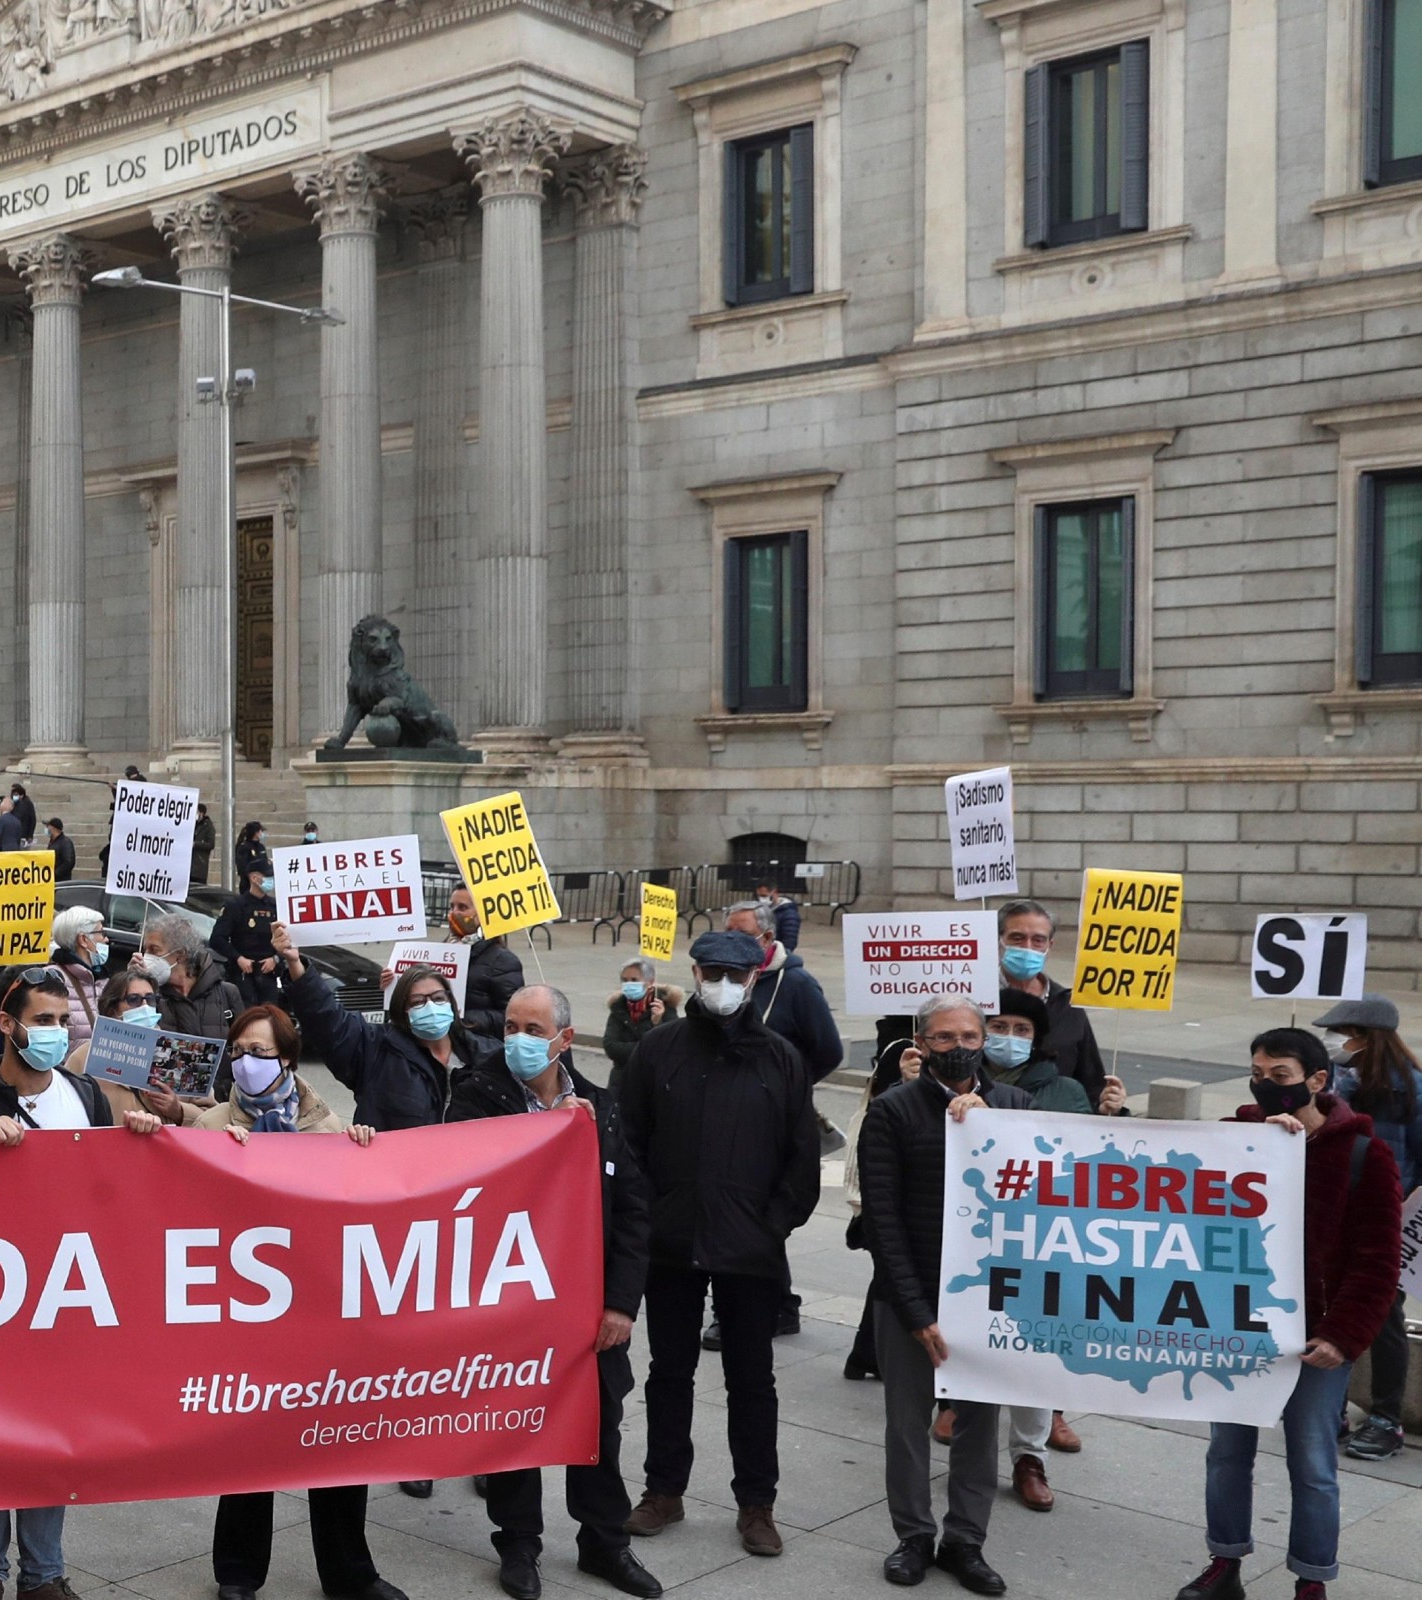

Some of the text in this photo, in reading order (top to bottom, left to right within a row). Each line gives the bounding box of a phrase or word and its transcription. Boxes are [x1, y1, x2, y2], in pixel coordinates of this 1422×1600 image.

[65, 171, 90, 200] DE
[106, 156, 146, 187] LOS
[164, 110, 297, 171] DIPUTADOS
[118, 786, 193, 826] Poder elegir
[955, 781, 1004, 816] ¡Sadismo
[126, 827, 174, 857] el morir
[458, 803, 525, 852] ¡NADIE
[960, 817, 1006, 847] sanitario,
[288, 848, 403, 874] #LIBRES
[467, 843, 541, 885] DECIDA
[957, 854, 1014, 886] nunca más!
[116, 864, 173, 895] sin sufrir.
[289, 871, 405, 892] HASTA EL
[1, 896, 46, 921] morir
[292, 888, 408, 922] FINAL
[482, 876, 551, 925] POR TÍ!
[643, 889, 674, 910] Derecho
[1092, 881, 1179, 915] ¡NADIE
[645, 916, 672, 931] a morir
[868, 923, 971, 939] VIVIR ES
[1083, 923, 1176, 956] DECIDA
[10, 931, 46, 955] PAZ.
[402, 949, 456, 962] VIVIR ES
[643, 934, 653, 951] EN
[868, 944, 972, 957] UN DERECHO
[1255, 915, 1349, 997] SÍ
[870, 963, 972, 976] NO UNA
[870, 978, 972, 994] OBLIGACIÓN
[1078, 964, 1171, 999] POR TÍ!
[994, 1159, 1268, 1218] #LIBRES
[164, 1225, 293, 1325] ES
[340, 1188, 556, 1320] MÍA
[990, 1212, 1269, 1276] HASTA EL
[988, 1267, 1269, 1333] FINAL
[988, 1317, 1269, 1355] ASOCIACIÓN DERECHO A
[988, 1334, 1269, 1370] MORIR DIGNAMENTE
[179, 1347, 555, 1414] #libreshastaelfinal
[300, 1404, 546, 1447] derechoamorir.org
